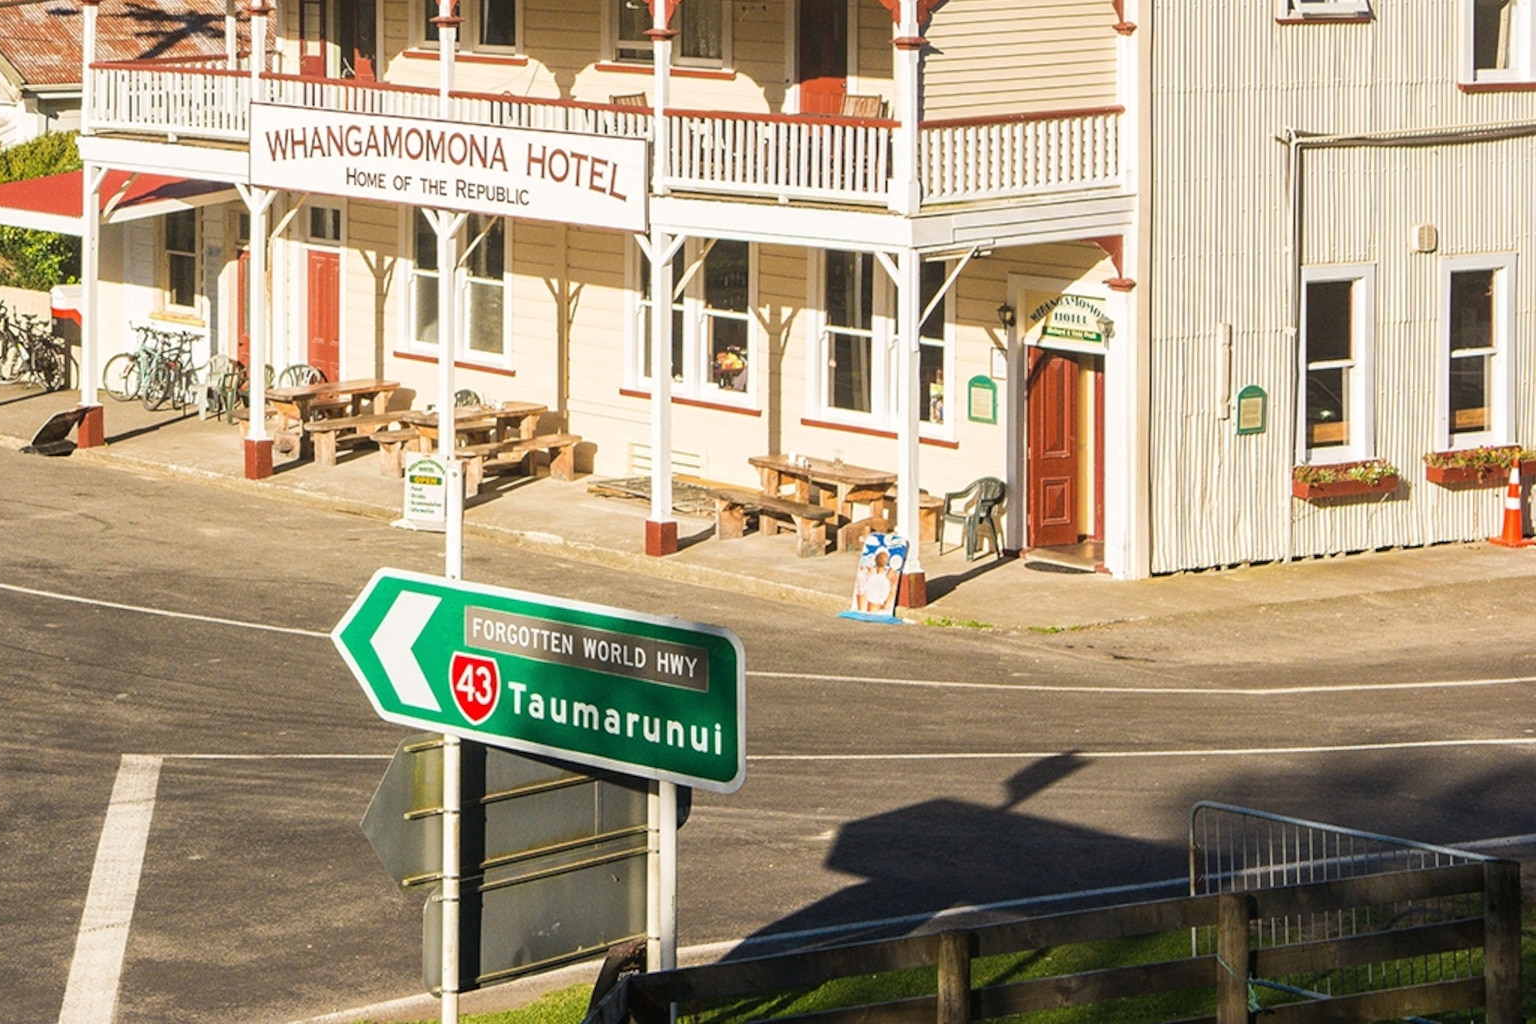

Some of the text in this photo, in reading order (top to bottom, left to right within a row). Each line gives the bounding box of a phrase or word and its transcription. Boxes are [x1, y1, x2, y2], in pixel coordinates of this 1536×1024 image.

[265, 124, 628, 203] WHANGAMOMONA HOTEL
[346, 166, 530, 207] HOME OF THE REPUBLIC
[413, 475, 438, 485] OPEN
[472, 617, 699, 678] FORGOTTEN WORLD HWY
[455, 663, 723, 756] 43 Taumarunui
